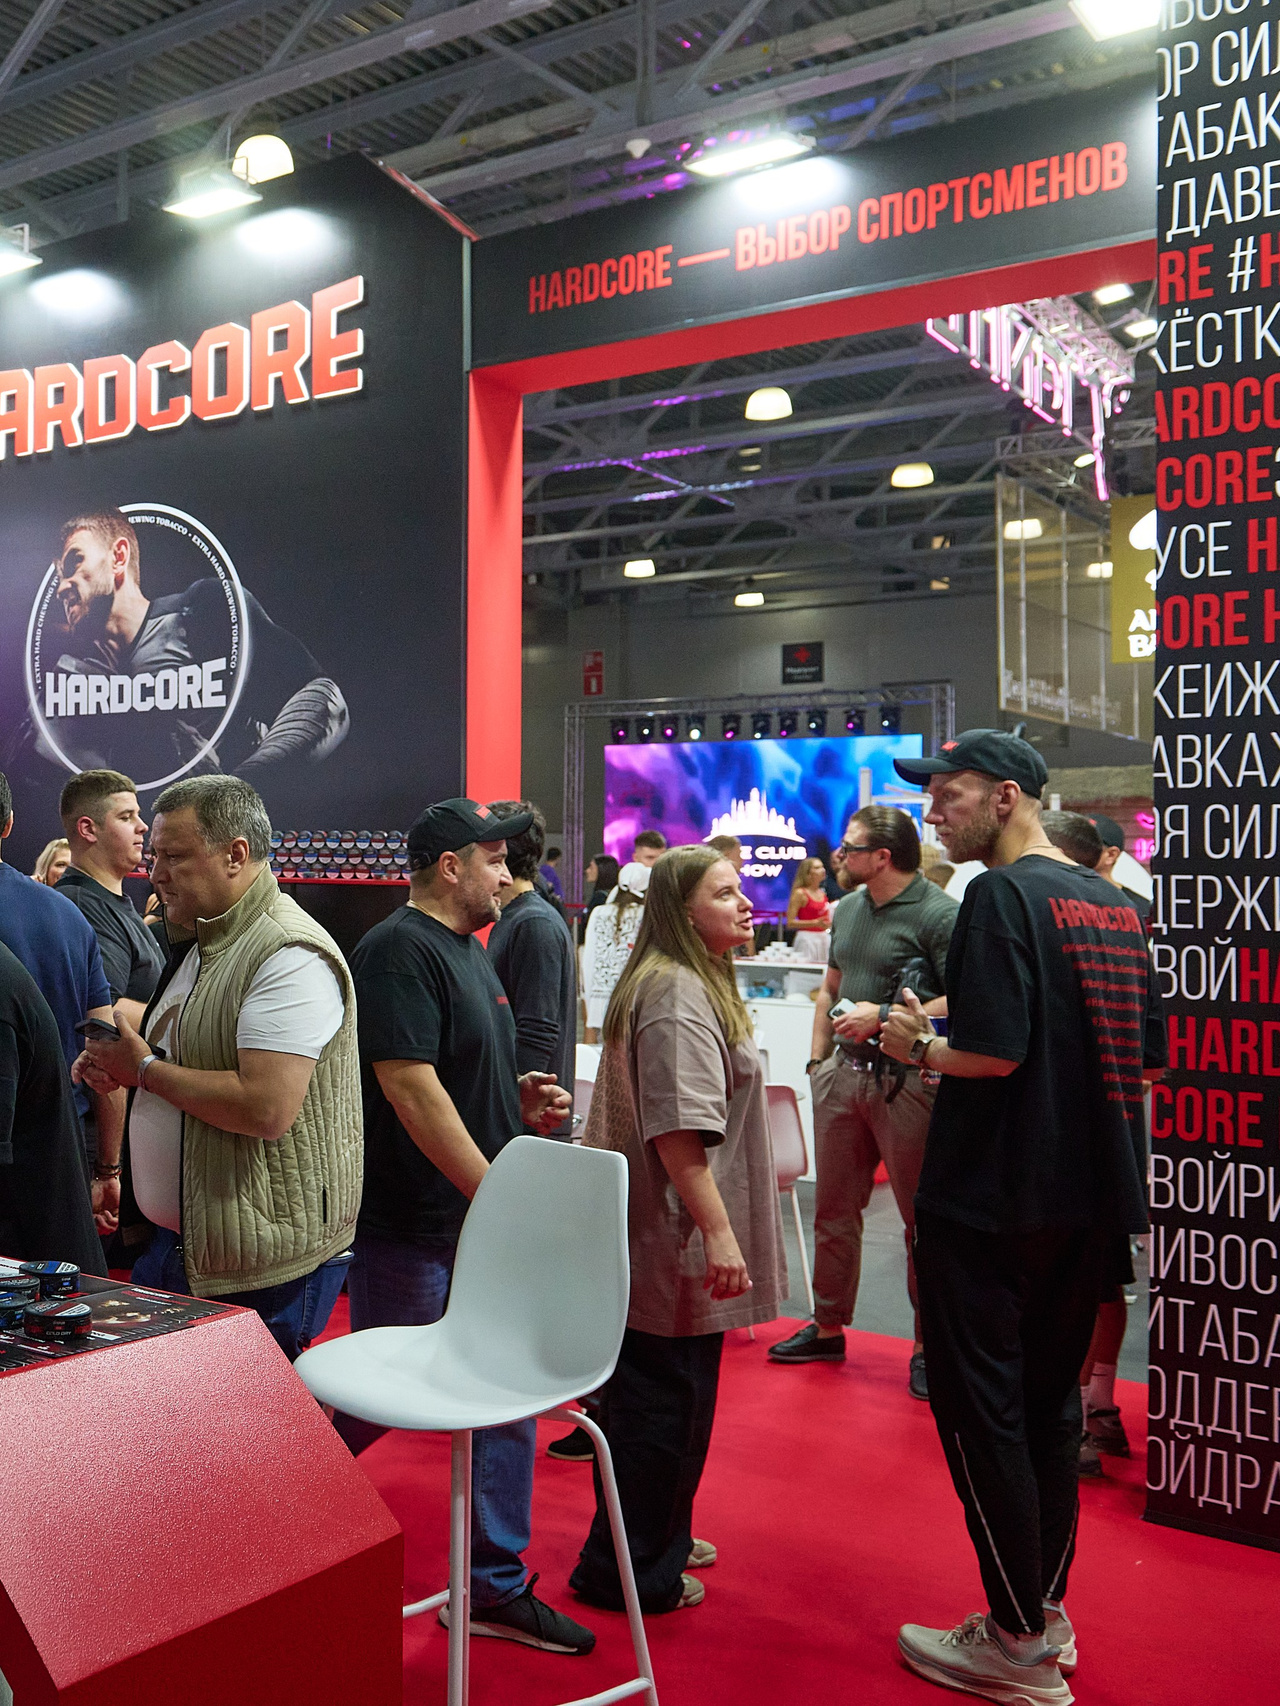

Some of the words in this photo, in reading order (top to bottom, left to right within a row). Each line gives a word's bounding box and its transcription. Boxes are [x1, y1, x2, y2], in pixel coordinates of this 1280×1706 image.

[1156, 90, 1280, 167] АБАК
[529, 245, 673, 314] HARDCORE
[735, 204, 851, 271] ВЫБОР
[857, 141, 1128, 244] СПОРТСМЕНОВ
[1155, 159, 1280, 243] ДАВЕ
[1158, 243, 1214, 306] RE
[1154, 301, 1280, 374] ЁСТК
[1156, 446, 1280, 511] CORE
[127, 515, 156, 526] EWING
[155, 516, 189, 537] TOBACCO
[191, 534, 212, 559] EXTRA
[1247, 516, 1280, 574] H
[209, 555, 227, 580] HARD
[37, 585, 55, 628] CHEWING
[221, 578, 239, 626] CHEWING
[1155, 590, 1250, 650] ORE
[34, 629, 43, 654] HARD
[229, 624, 239, 669] TOBACCO
[44, 657, 227, 718] HARDCORE
[754, 845, 808, 861] CLUB
[1152, 804, 1190, 859] Я
[1152, 874, 1280, 936] ЕРЖ
[1150, 1083, 1264, 1149] CORE
[1149, 1224, 1278, 1295] ИВОС
